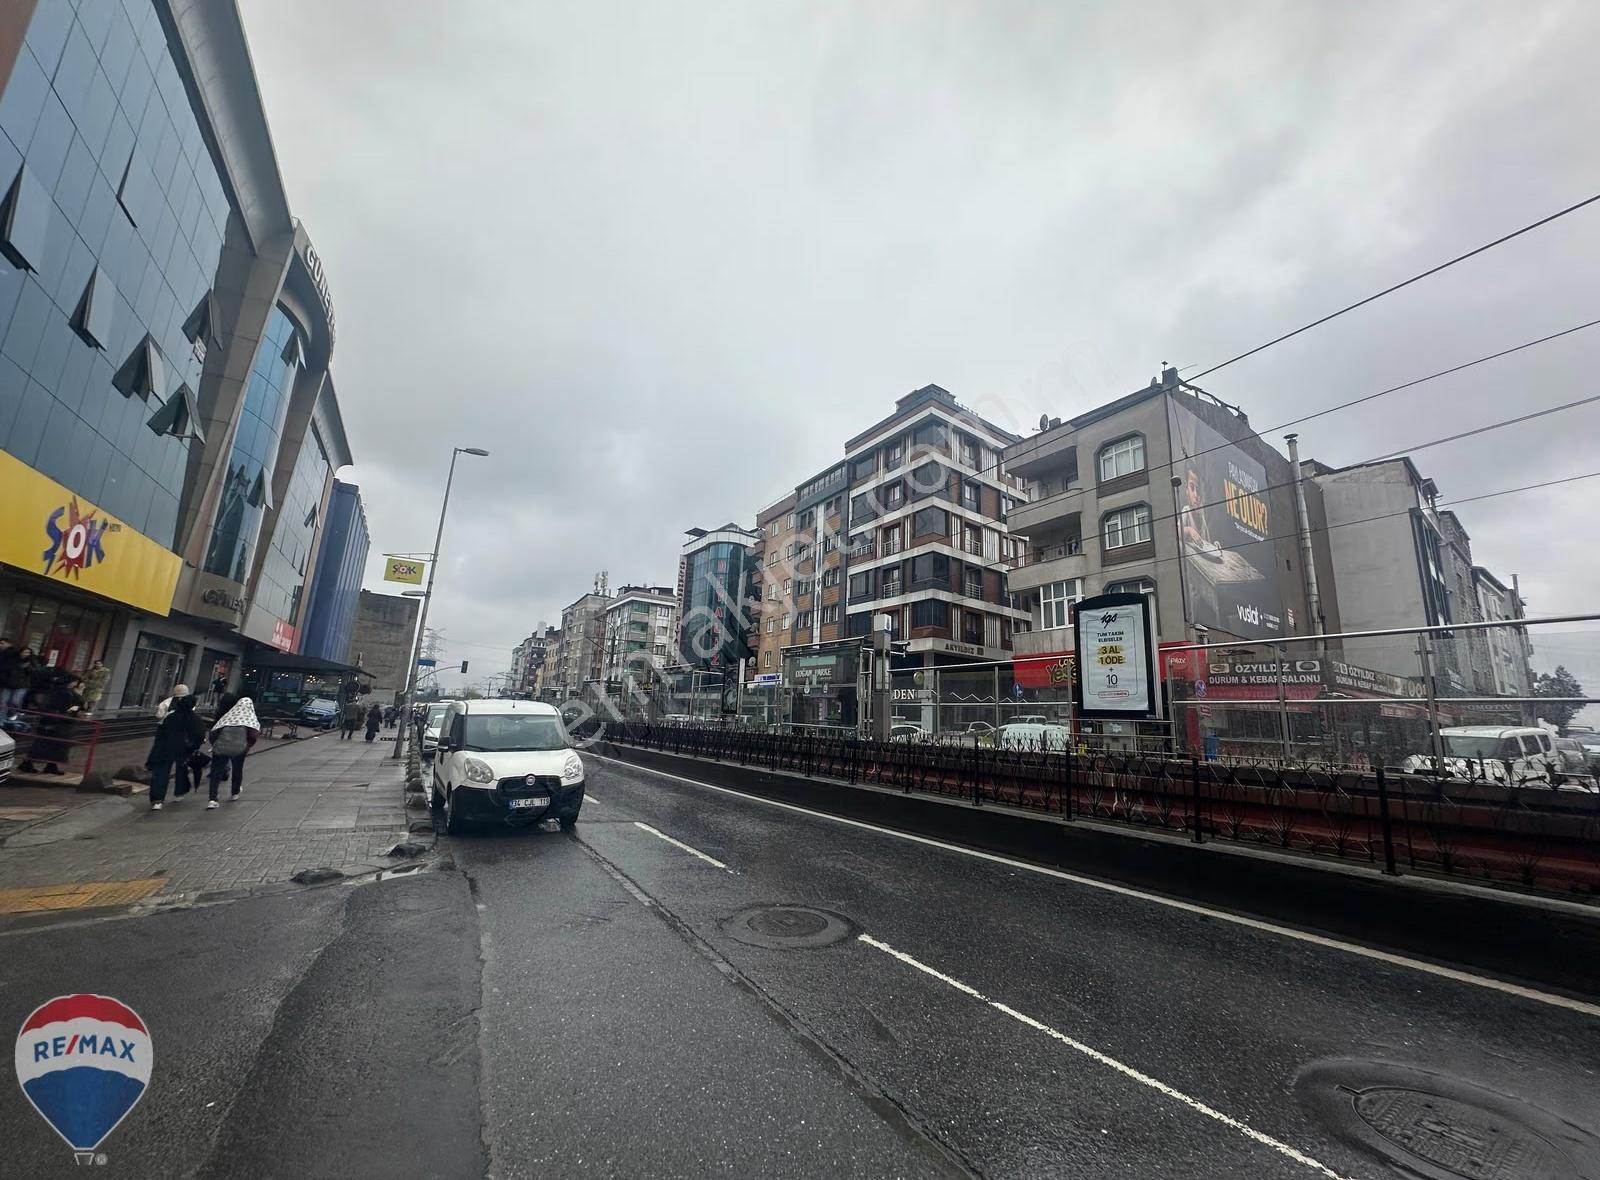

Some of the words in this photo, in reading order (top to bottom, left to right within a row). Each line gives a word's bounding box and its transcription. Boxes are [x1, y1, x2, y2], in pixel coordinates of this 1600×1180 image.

[1223, 478, 1239, 519] NE
[1101, 646, 1107, 654] 3
[1099, 657, 1104, 665] 1
[1235, 662, 1290, 673] ÖZYILDZ
[1106, 674, 1118, 685] 10
[1241, 675, 1248, 683] &
[1282, 674, 1320, 683] SALONU
